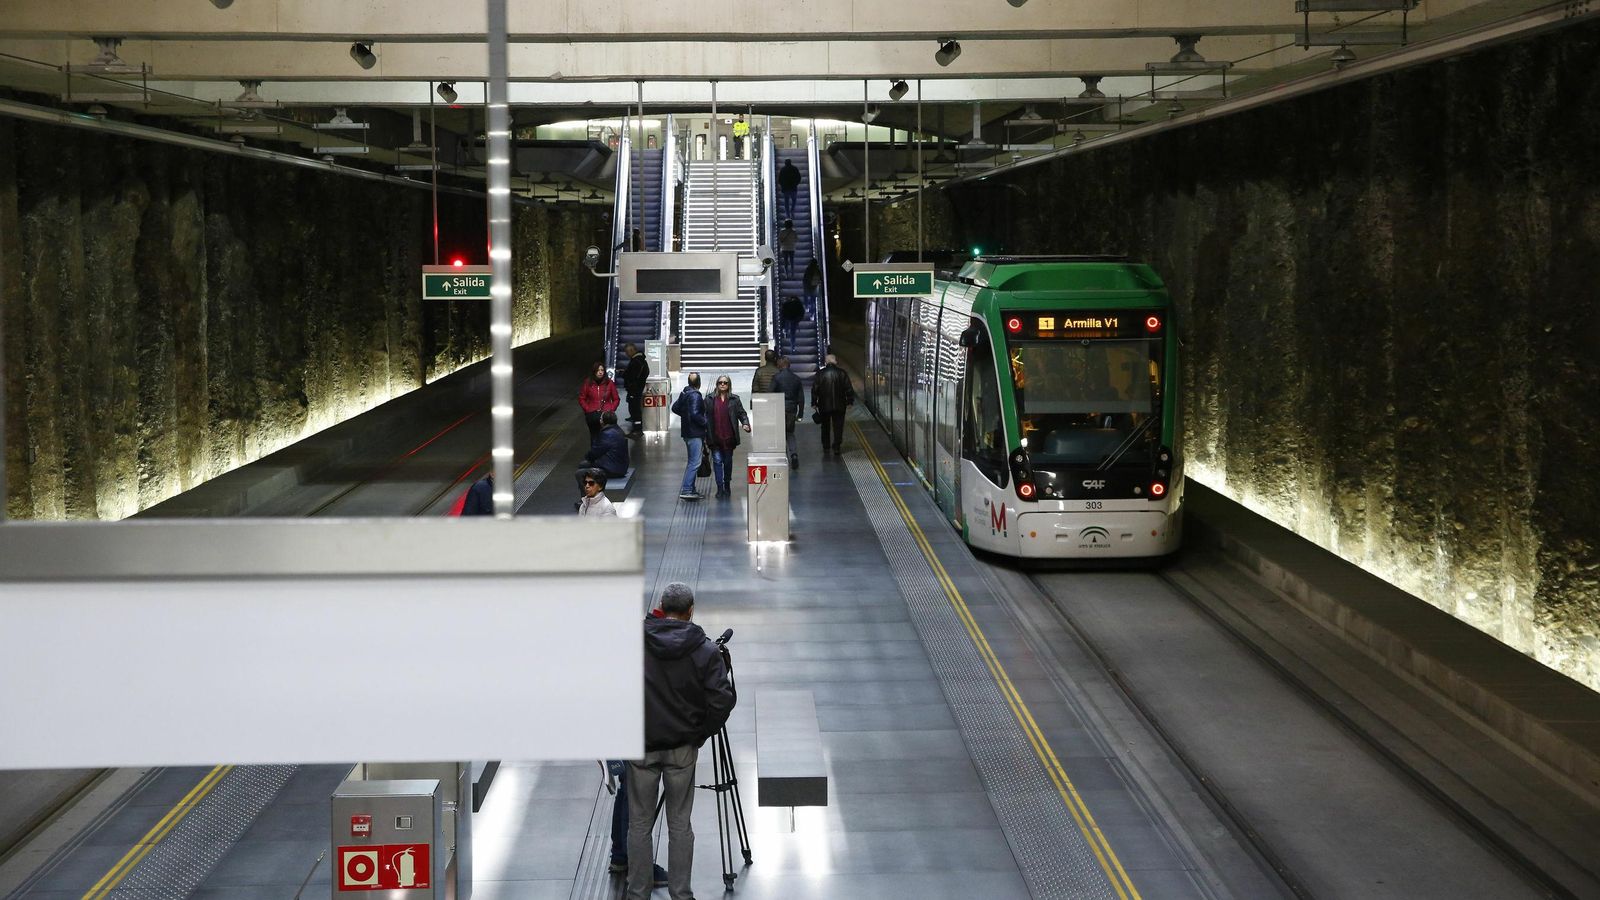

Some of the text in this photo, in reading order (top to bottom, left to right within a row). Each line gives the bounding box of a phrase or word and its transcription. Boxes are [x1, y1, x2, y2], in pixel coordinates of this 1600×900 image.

[453, 277, 485, 287] Salida
[883, 275, 915, 285] Salida
[1064, 318, 1102, 328] Armilla
[1104, 318, 1118, 328] V1
[1082, 480, 1106, 489] CAF
[1085, 501, 1103, 510] 303
[991, 500, 1007, 534] M
